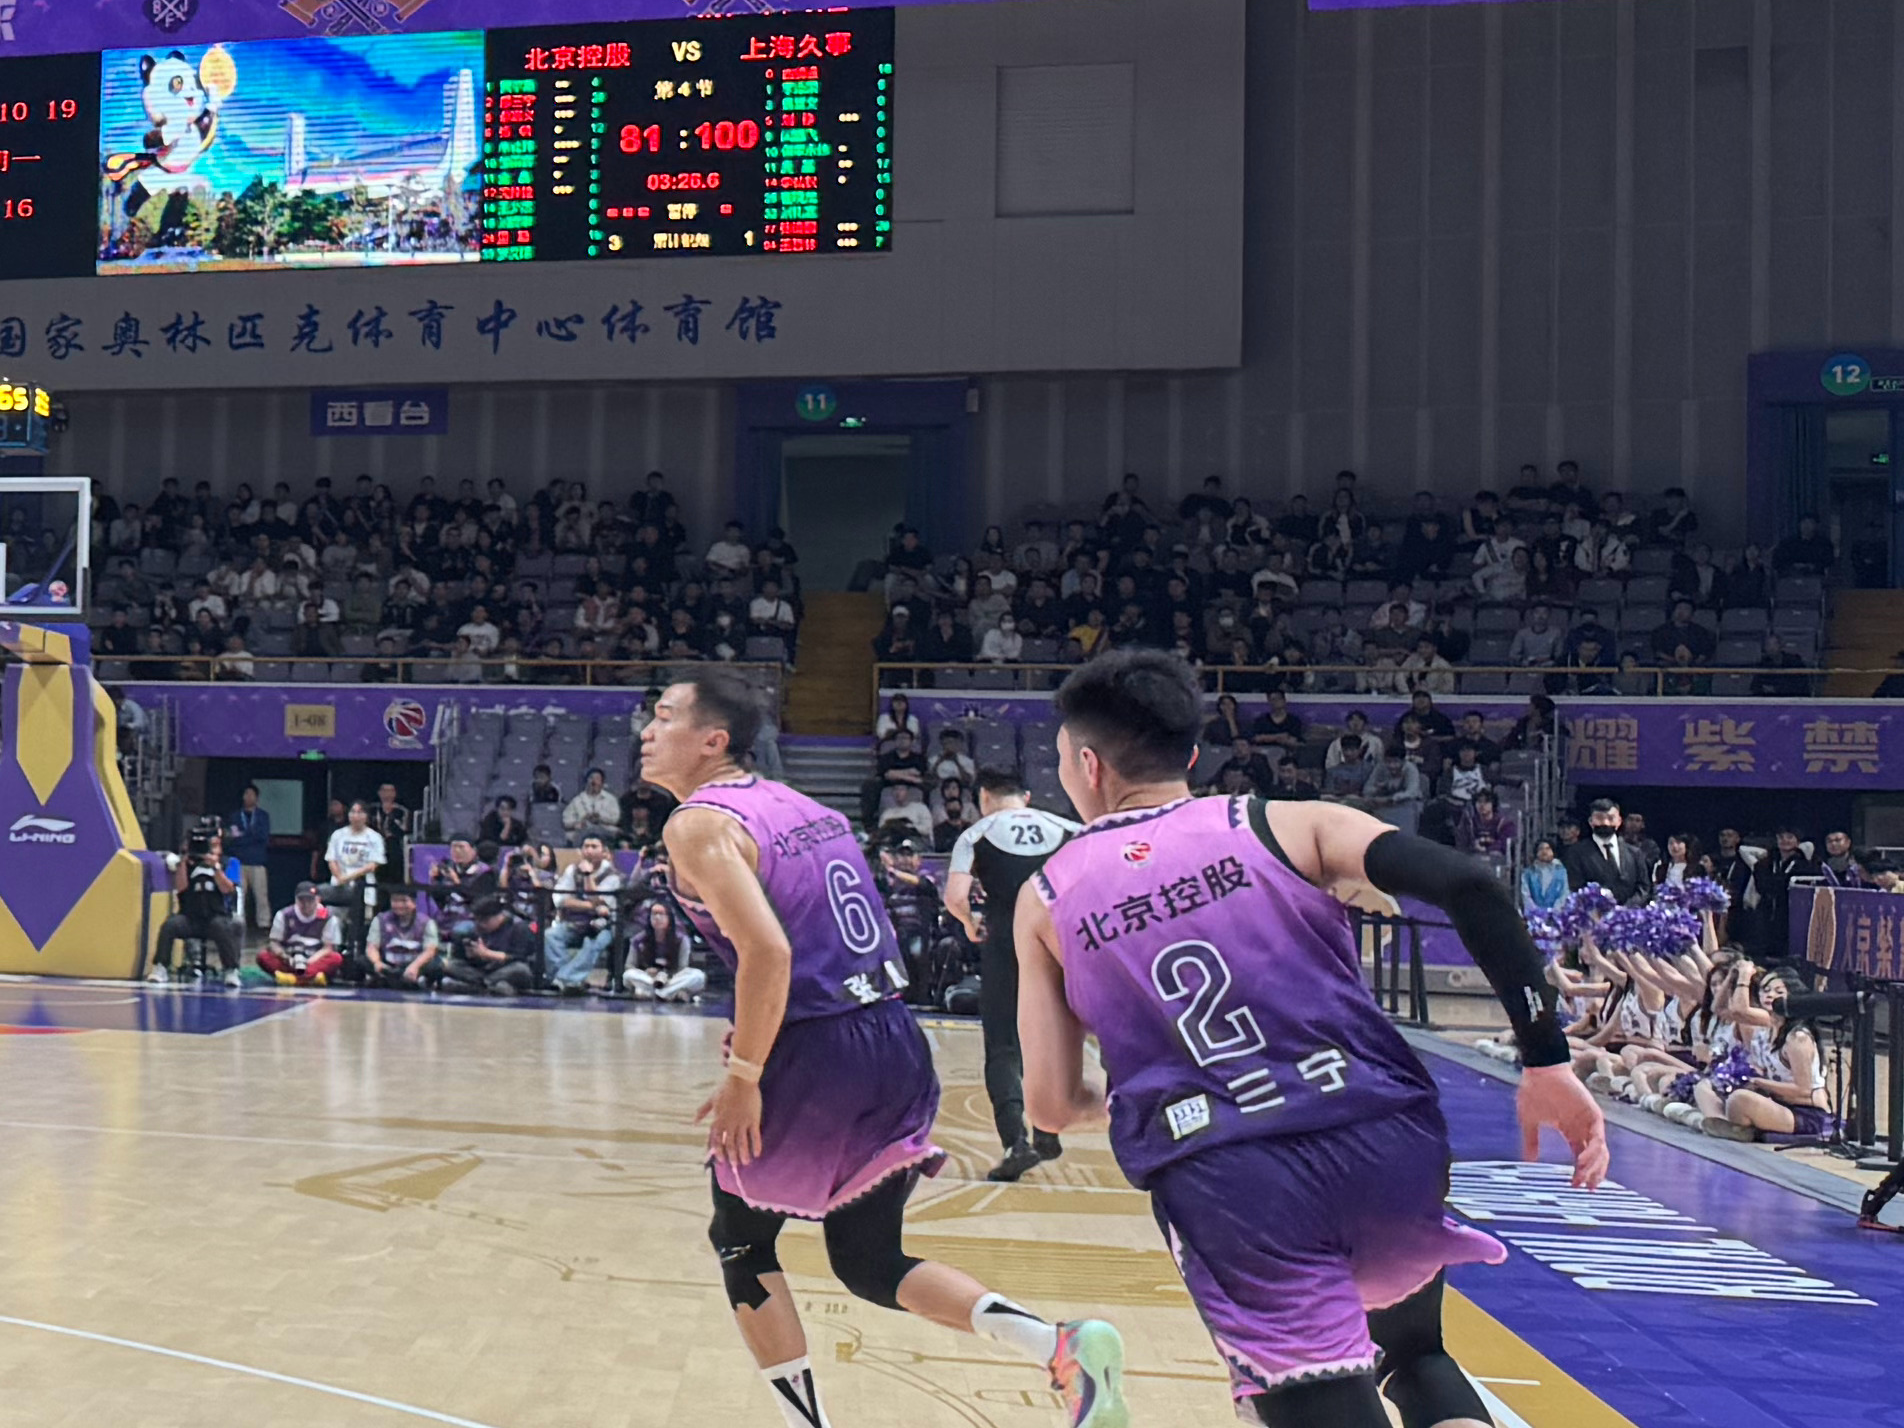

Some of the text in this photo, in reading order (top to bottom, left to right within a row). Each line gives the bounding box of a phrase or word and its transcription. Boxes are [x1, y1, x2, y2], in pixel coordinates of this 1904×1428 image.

[525, 42, 632, 71] 北京控股
[671, 41, 702, 62] VS
[740, 32, 853, 61] 上海久事
[48, 99, 77, 121] 19
[620, 124, 661, 152] 81
[695, 120, 760, 150] 100
[608, 235, 622, 251] 3
[1832, 365, 1861, 383] 12
[805, 394, 826, 410] 11
[1010, 824, 1044, 845] 23
[826, 859, 880, 954] 6
[1077, 856, 1252, 951] 北京控股
[1152, 940, 1266, 1067] 2
